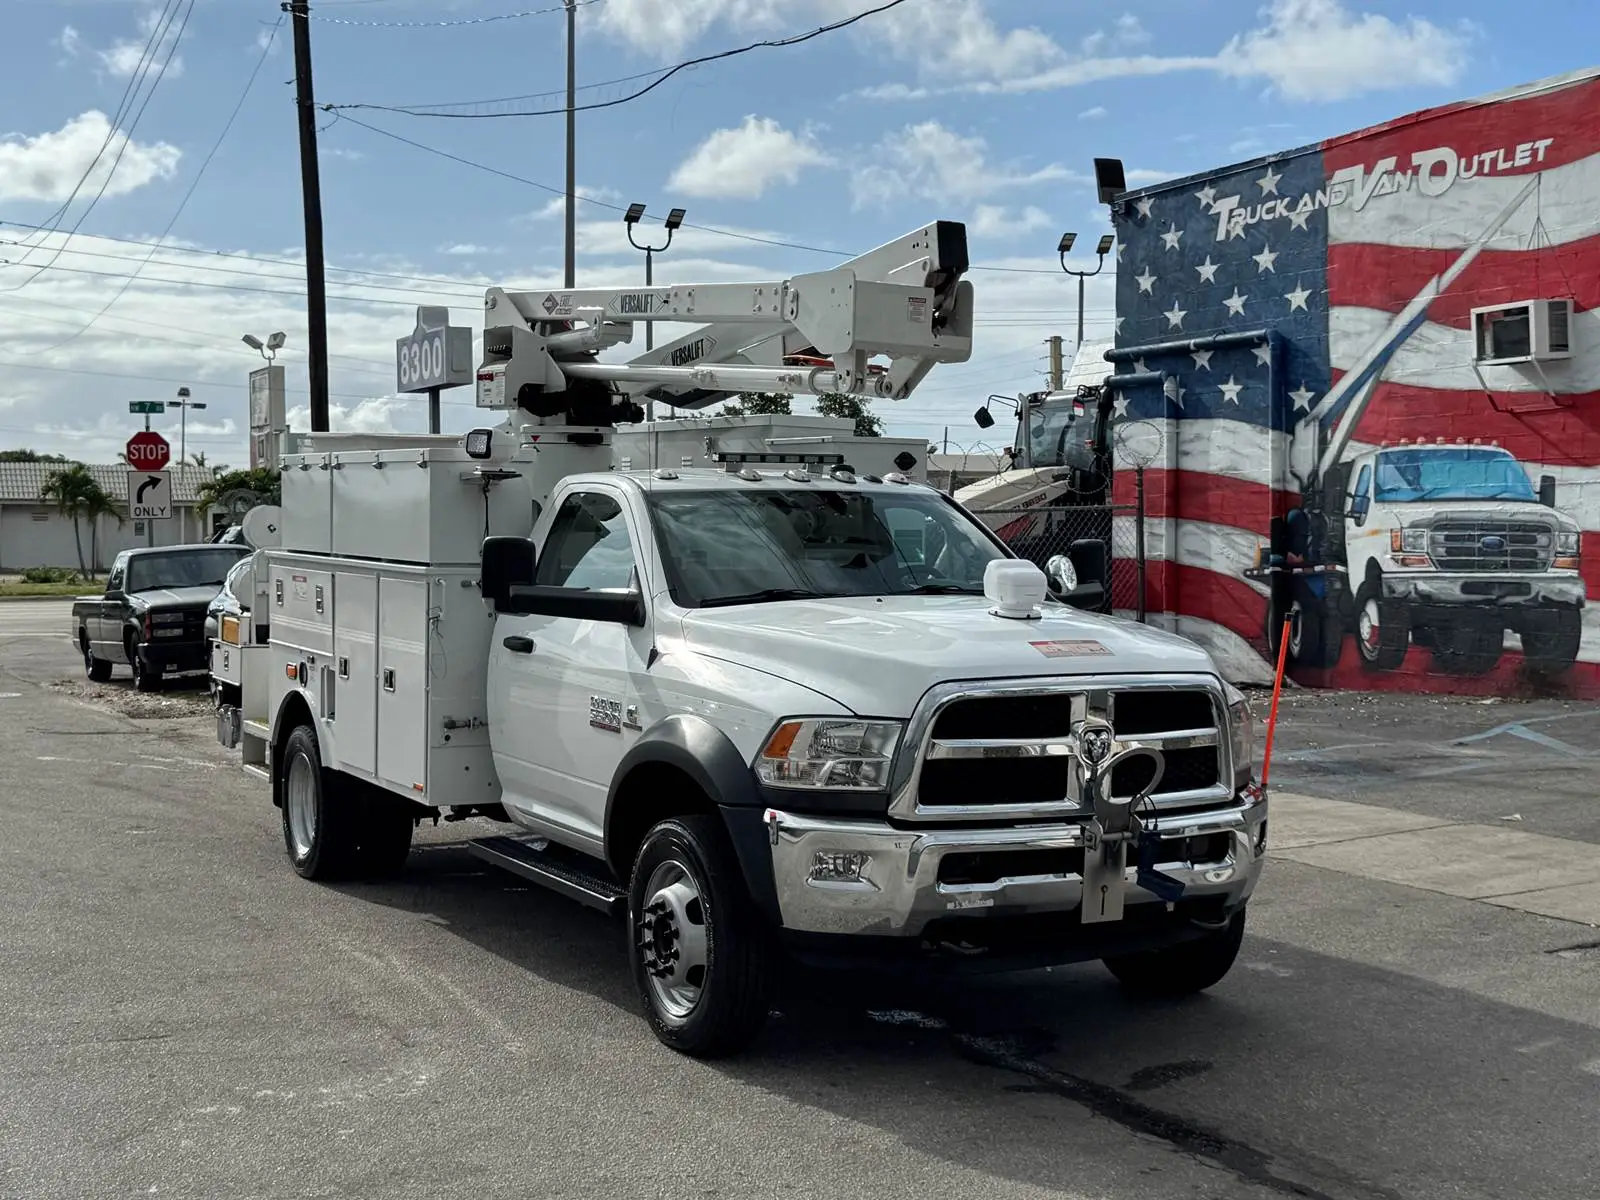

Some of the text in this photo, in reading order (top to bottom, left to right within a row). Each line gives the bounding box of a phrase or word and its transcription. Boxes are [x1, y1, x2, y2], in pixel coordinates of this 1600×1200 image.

[1208, 194, 1293, 242] TRUCK
[1291, 185, 1348, 214] AND
[1412, 138, 1554, 197] OUTLET
[620, 294, 654, 314] VERSALIFT
[400, 336, 442, 385] 8300
[670, 338, 704, 366] VERSALIFT
[129, 444, 168, 460] STOP
[134, 507, 166, 517] ONLY
